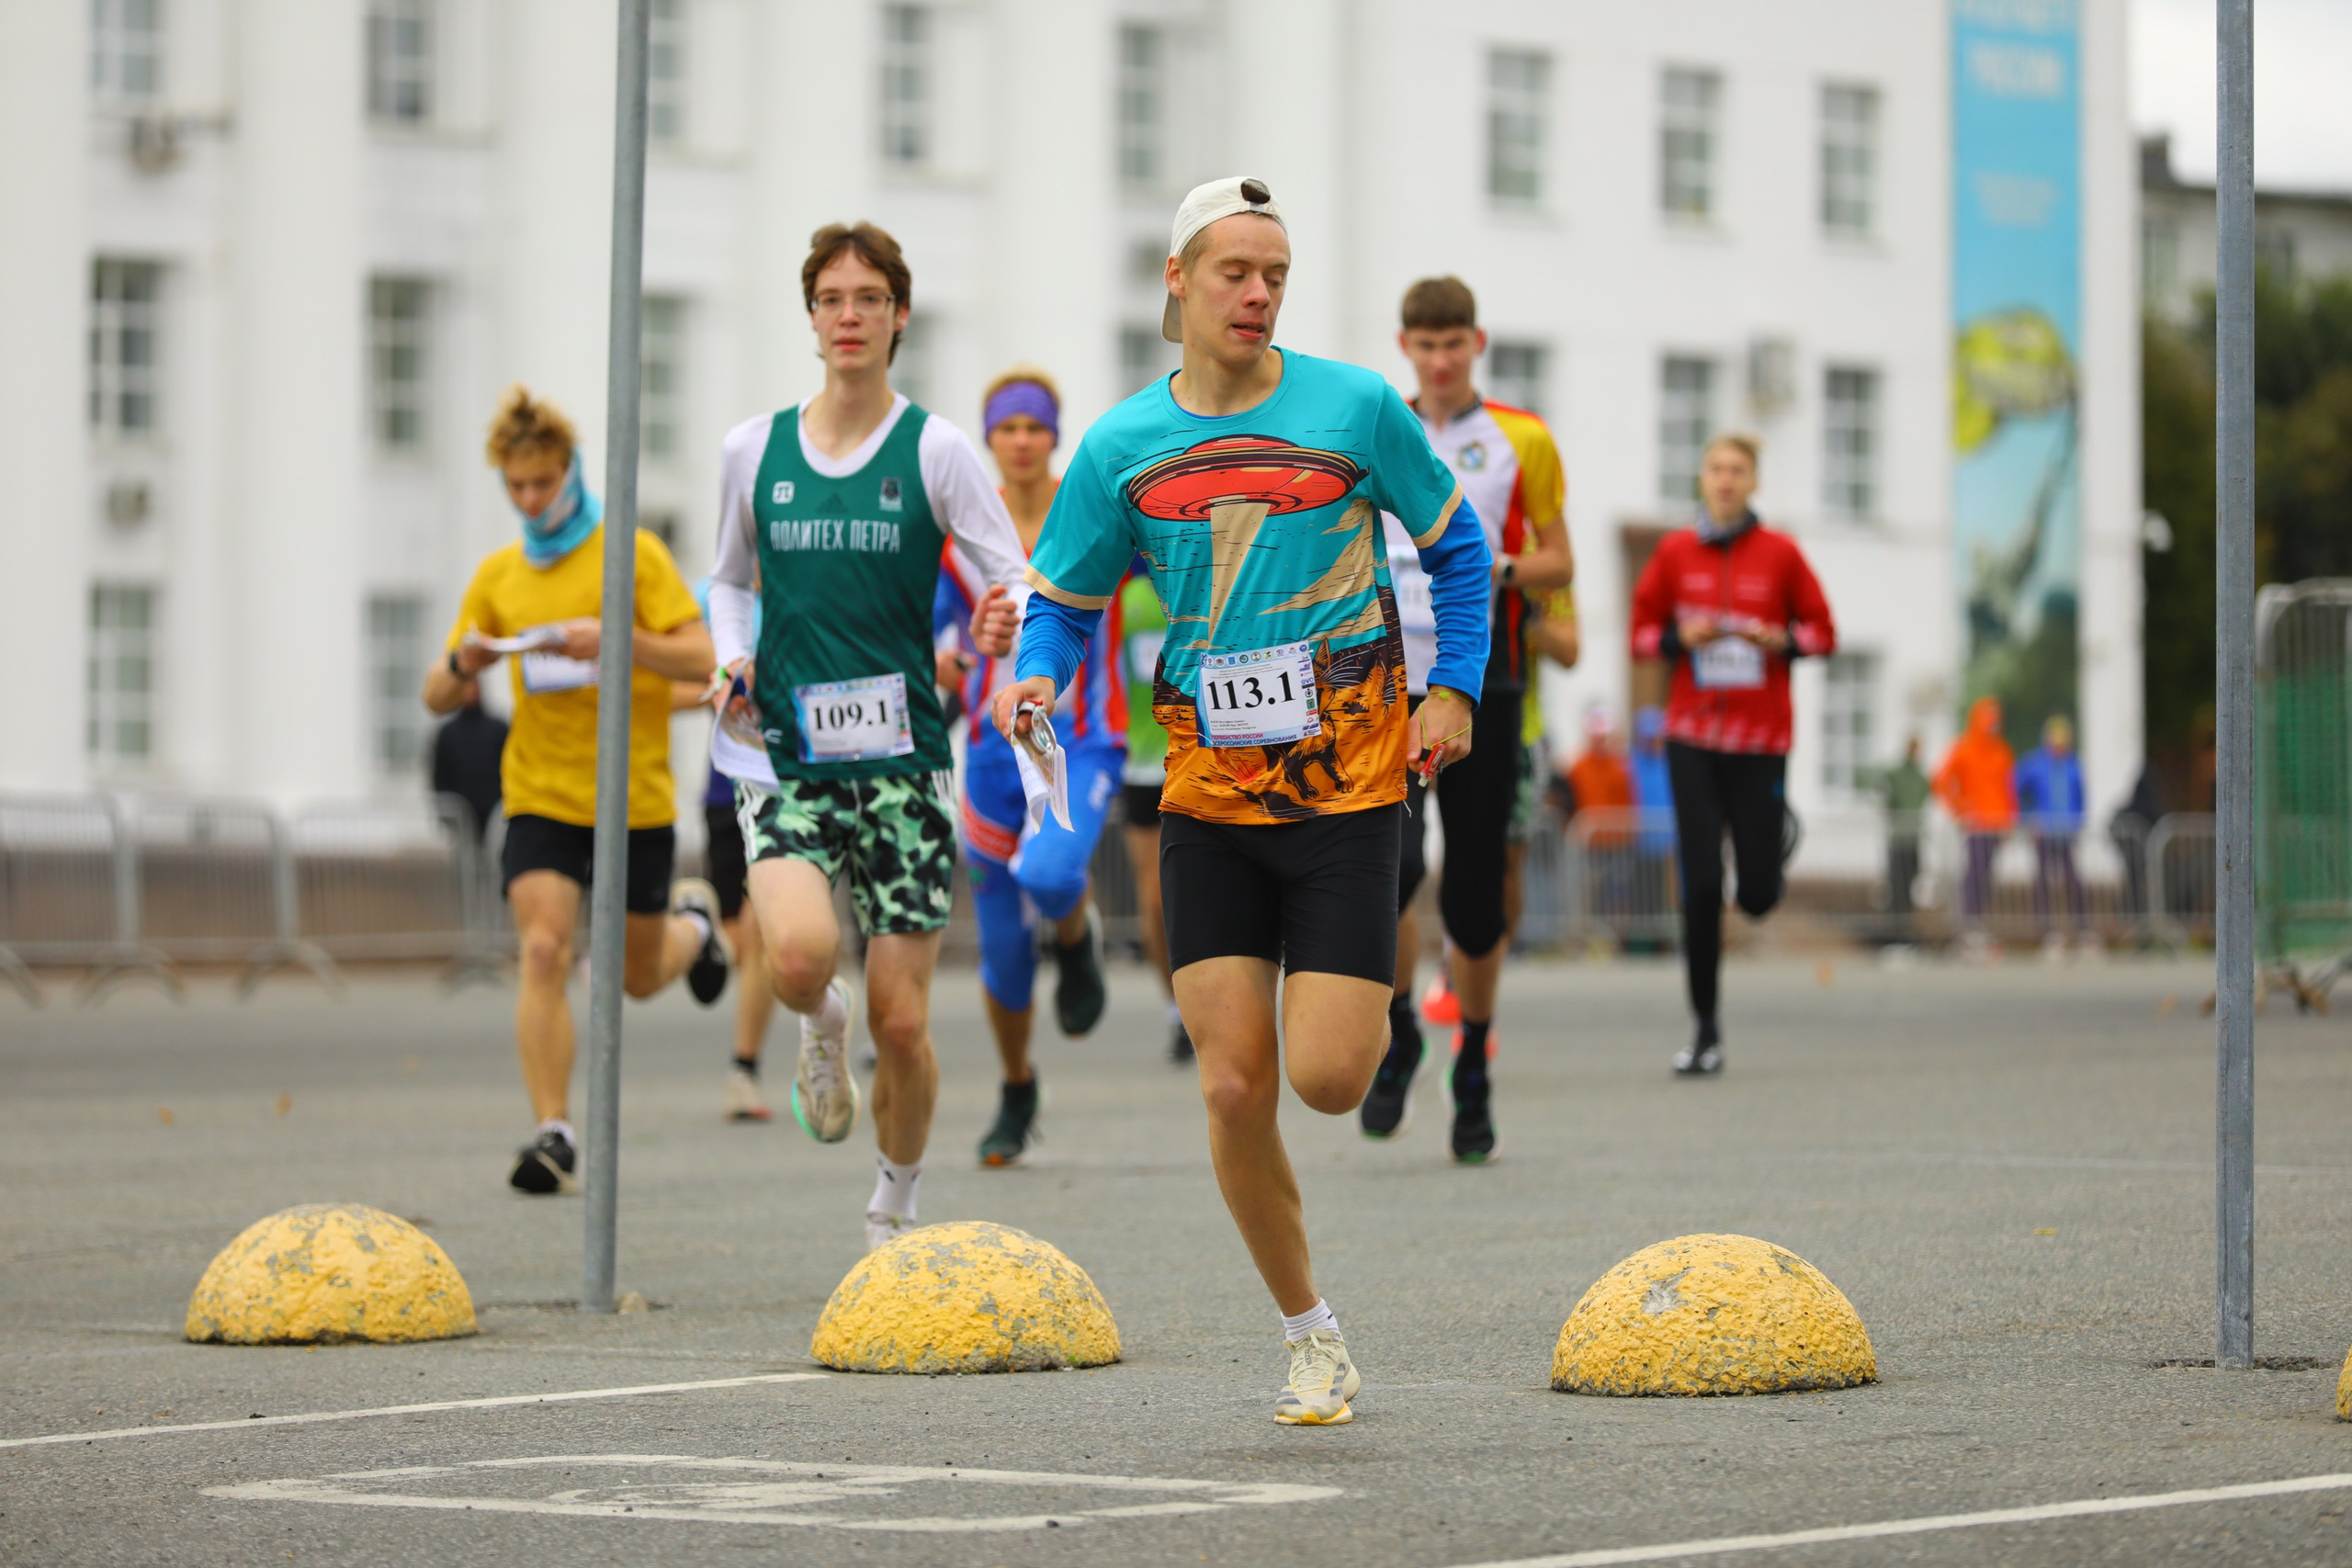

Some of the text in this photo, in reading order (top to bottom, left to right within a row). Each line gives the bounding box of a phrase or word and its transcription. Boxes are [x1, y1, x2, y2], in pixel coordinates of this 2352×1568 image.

[770, 519, 900, 554] ПОЛИТЕХ ПЕТРА
[1206, 671, 1296, 710] 113.1
[813, 699, 889, 731] 109.1
[1253, 734, 1297, 745] СОРЕВНОВАНИЯ
